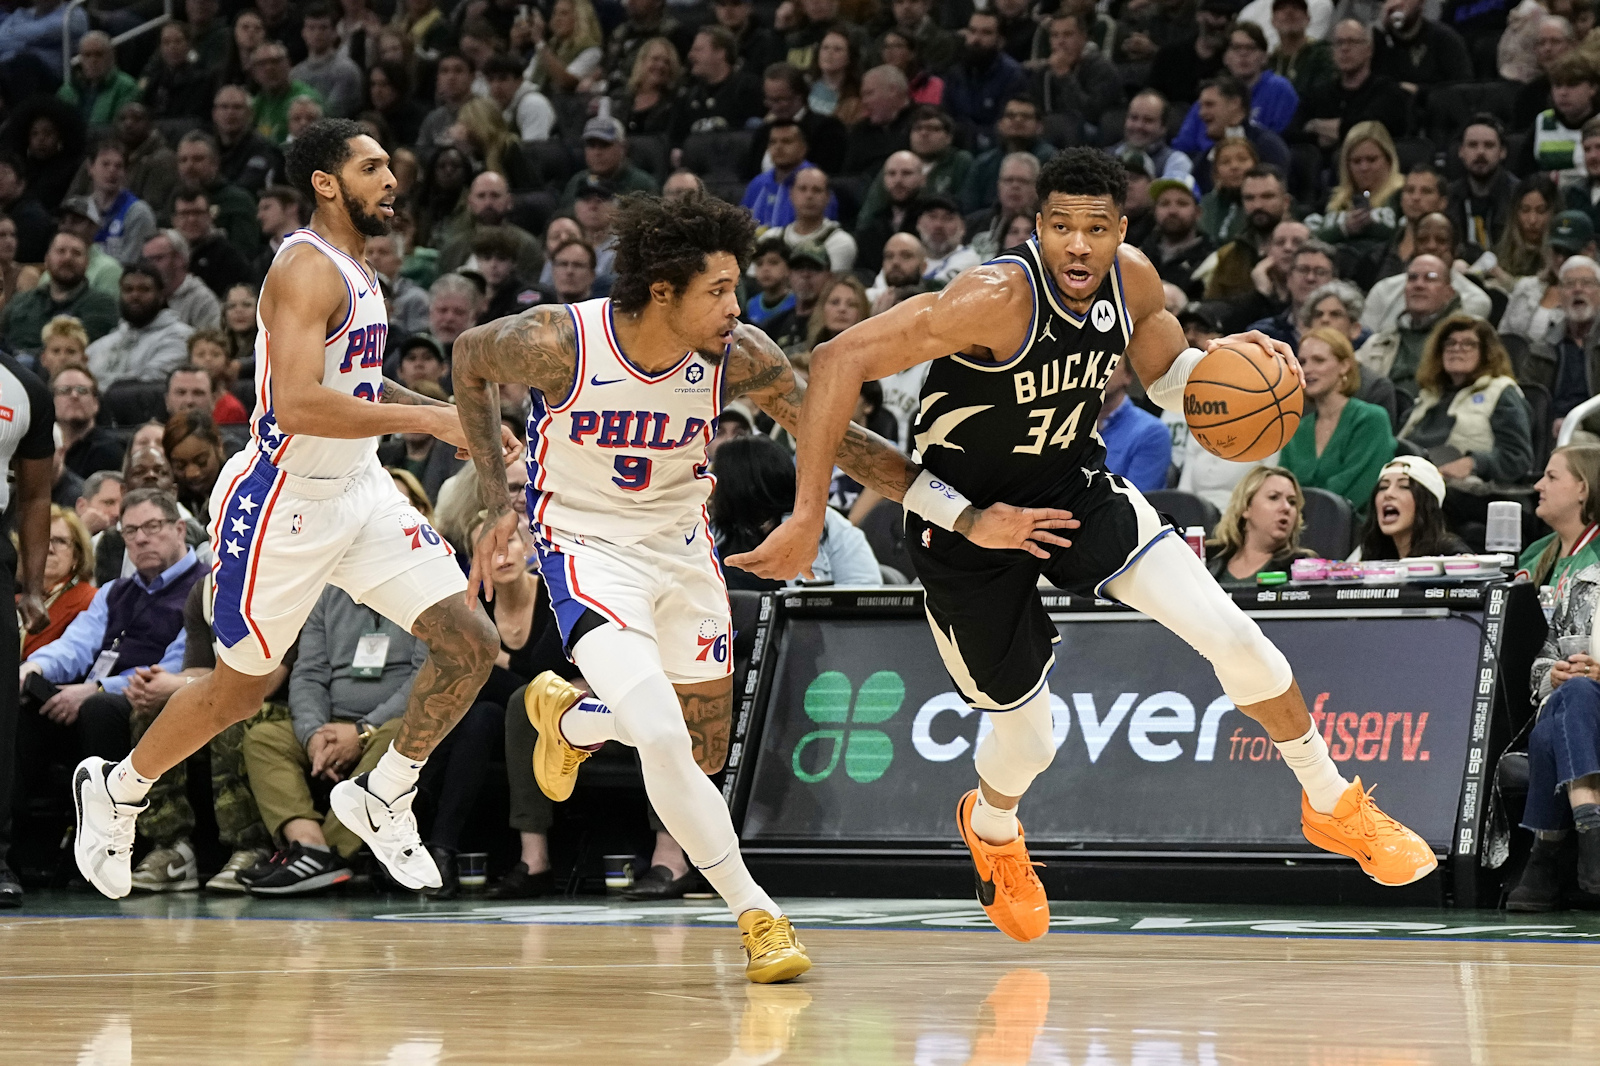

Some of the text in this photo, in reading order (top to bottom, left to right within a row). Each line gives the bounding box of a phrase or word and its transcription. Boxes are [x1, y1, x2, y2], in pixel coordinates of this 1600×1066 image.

[1014, 351, 1121, 404] BUCKS
[1183, 393, 1229, 415] ilson
[1012, 401, 1086, 456] 34
[611, 454, 652, 491] 9
[402, 523, 441, 550] 76
[695, 633, 727, 663] 76
